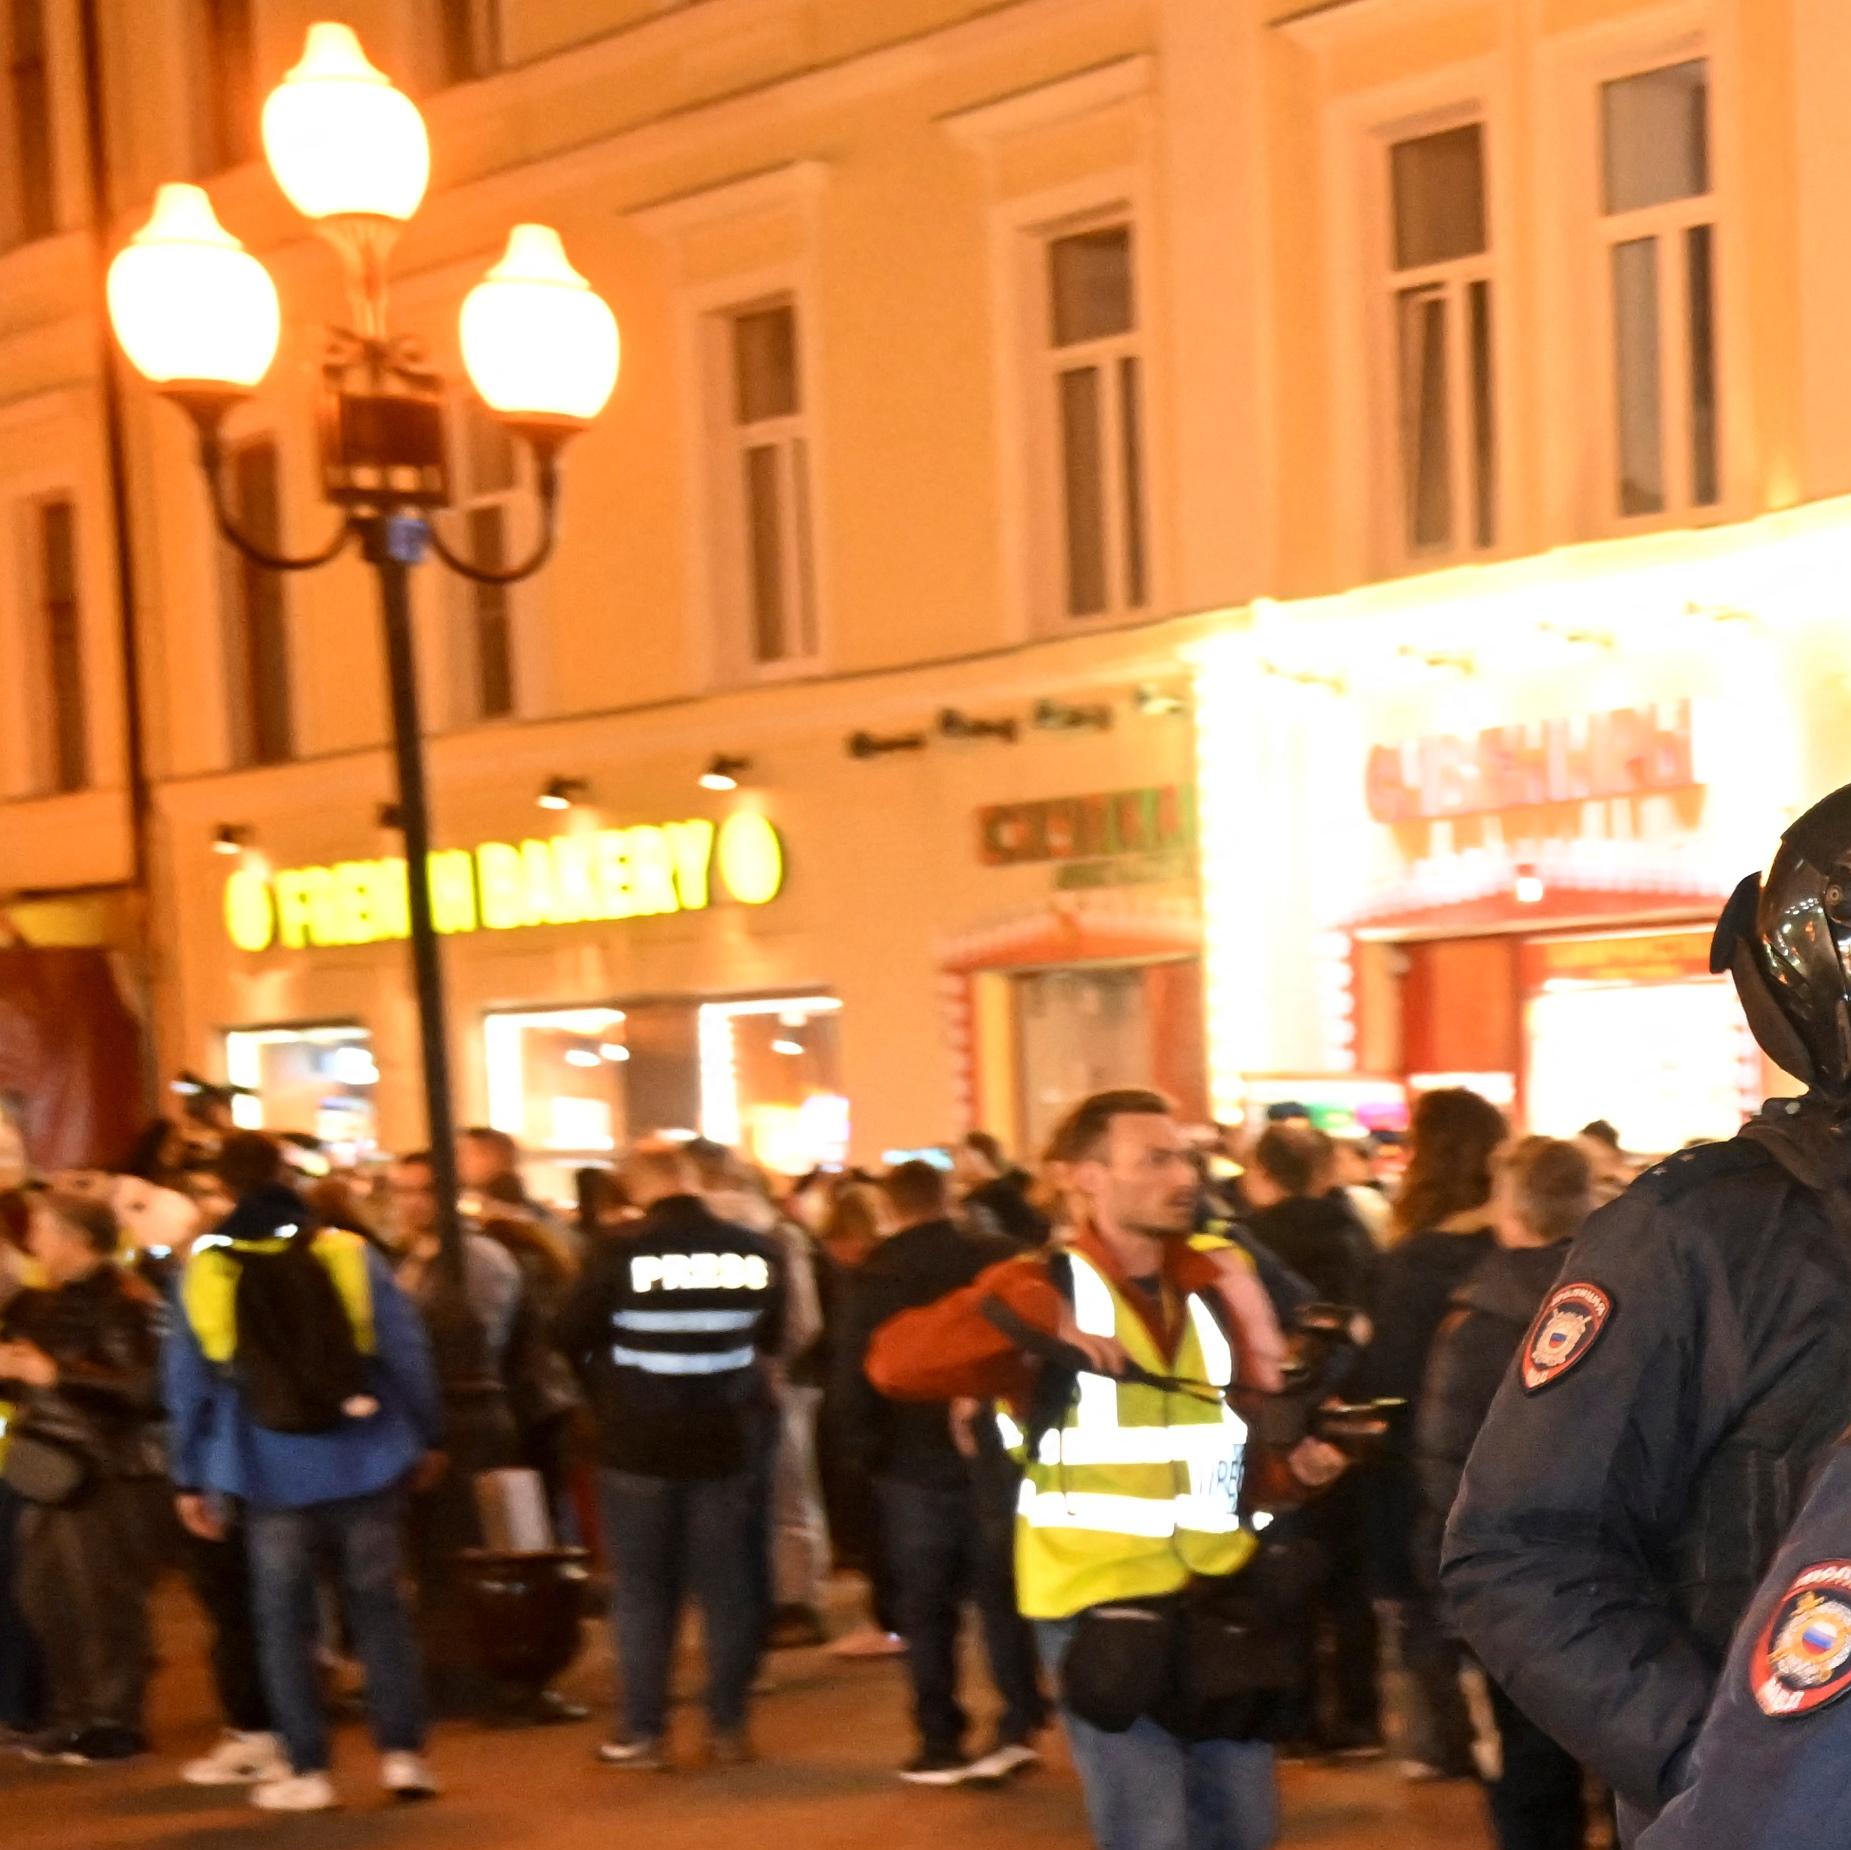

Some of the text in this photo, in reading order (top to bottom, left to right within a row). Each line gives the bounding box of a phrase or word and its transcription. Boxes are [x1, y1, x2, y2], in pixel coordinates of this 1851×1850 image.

[276, 819, 714, 949] FRENH BAKERY
[630, 1252, 769, 1294] PRESS
